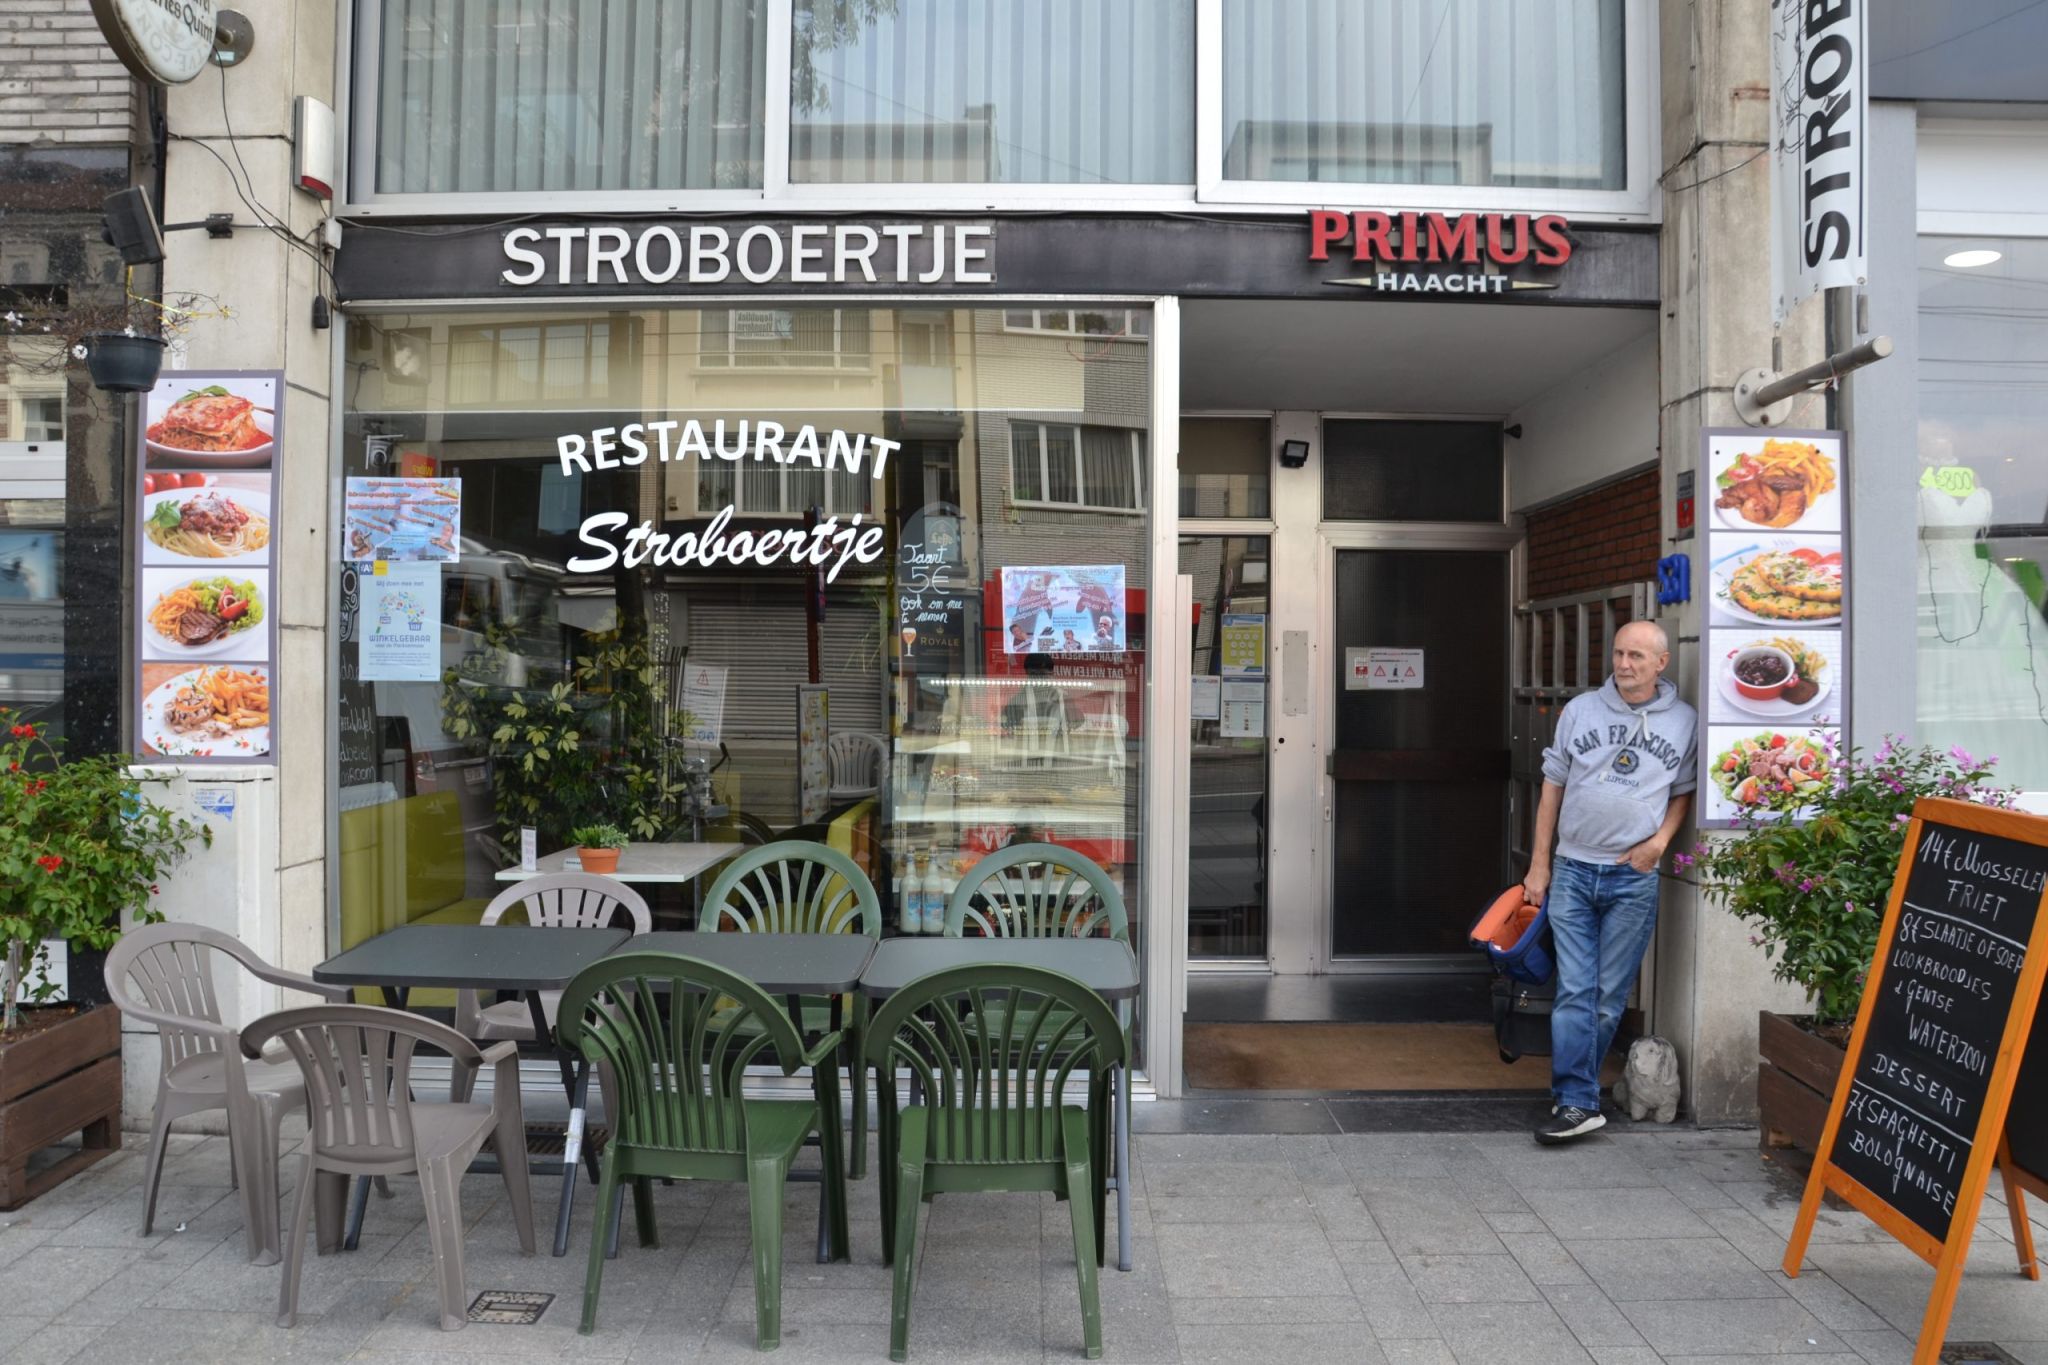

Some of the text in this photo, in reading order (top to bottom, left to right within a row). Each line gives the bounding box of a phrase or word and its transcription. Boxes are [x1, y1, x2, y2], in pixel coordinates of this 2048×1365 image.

[182, 4, 215, 44] Quint
[501, 224, 992, 286] STROBOERTJE
[1307, 209, 1573, 267] PRIMUS
[1377, 272, 1509, 294] HAACHT
[557, 418, 902, 480] RESTAURANT
[566, 504, 885, 584] Stroboertje
[902, 543, 948, 564] Taart
[906, 565, 952, 595] 5€
[1573, 729, 1602, 755] SAN
[1918, 830, 1957, 870] 14€
[1948, 880, 2008, 921] FRIET
[1920, 920, 1976, 952] SLAATJE
[1977, 938, 1996, 959] OF
[1994, 946, 2024, 973] SOEP
[1893, 949, 1991, 1001] LOOKBROODJES
[1905, 978, 1954, 1014] GENTSE
[1908, 1013, 1987, 1076] WATERZOOI
[1872, 1053, 1967, 1117] DESSERT
[1866, 1099, 1956, 1173] SPAGHETTI
[1849, 1129, 1955, 1216] BOLOGNAISE
